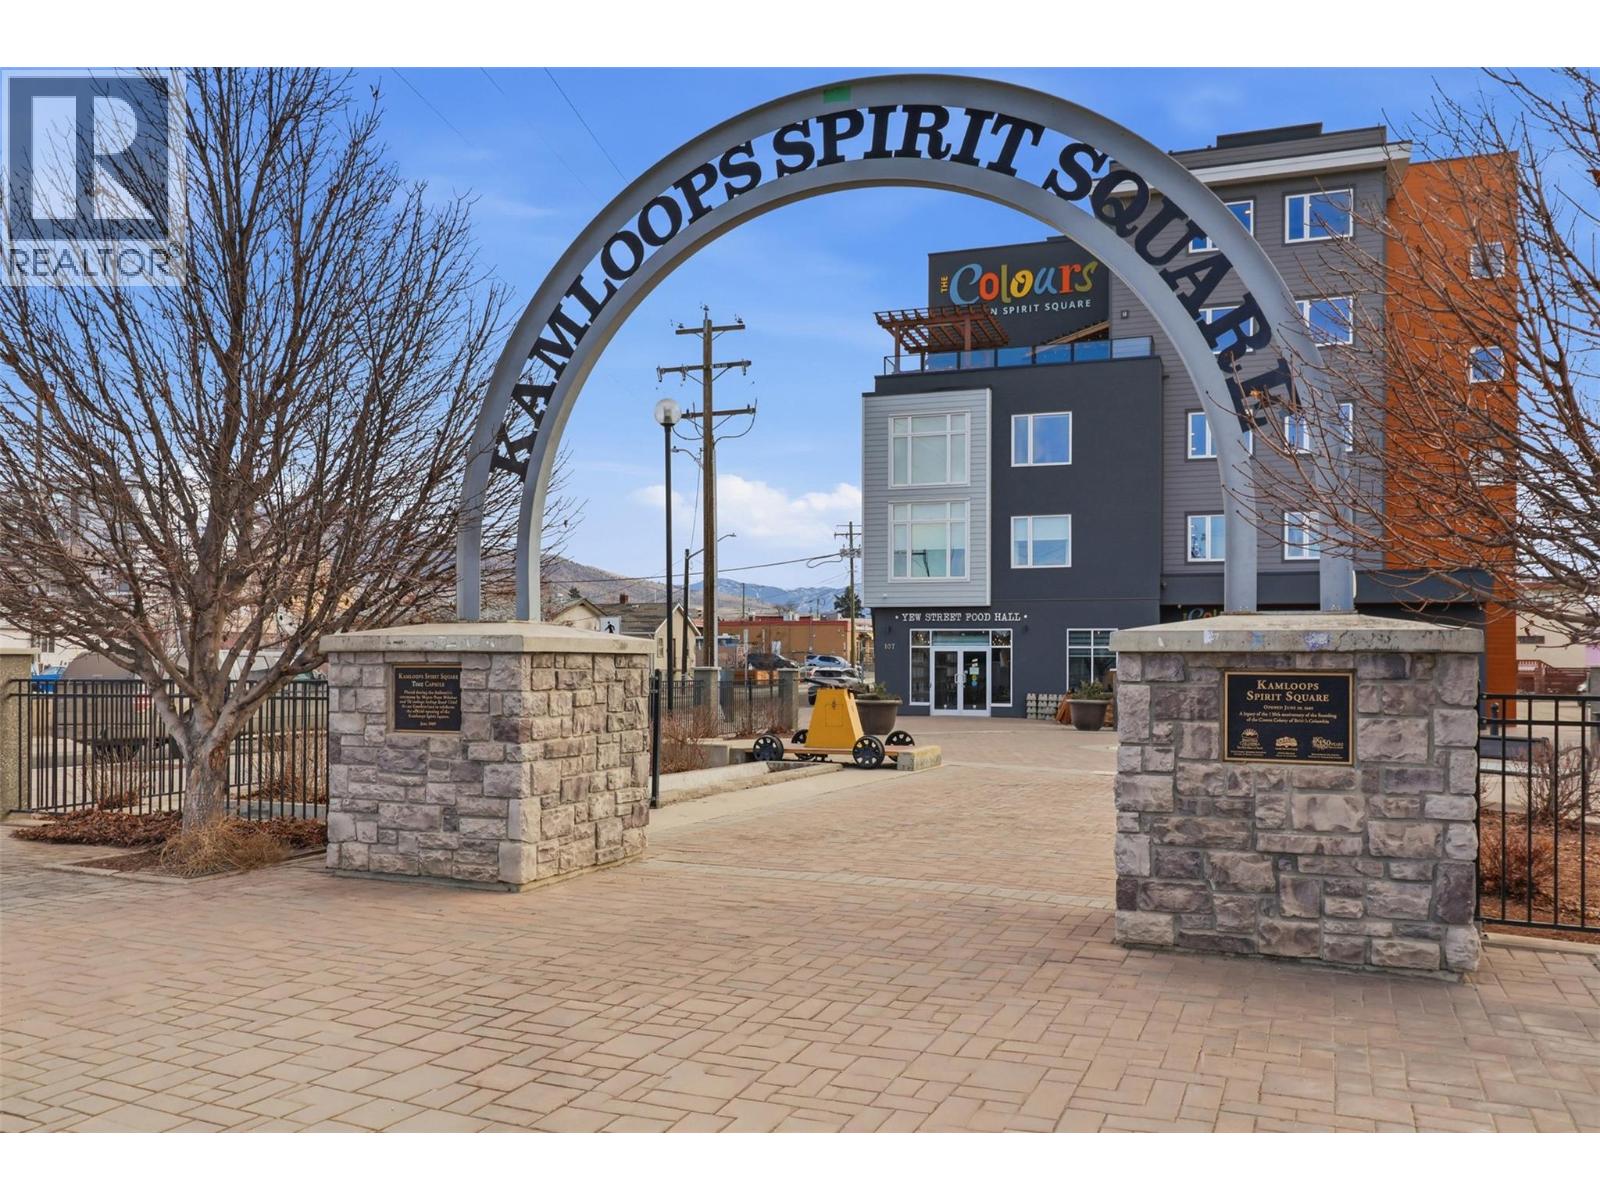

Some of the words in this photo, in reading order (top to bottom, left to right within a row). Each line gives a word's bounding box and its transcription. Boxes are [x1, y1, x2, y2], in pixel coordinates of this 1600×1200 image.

[940, 275, 949, 293] THE
[949, 261, 1098, 305] Colours
[489, 140, 761, 482] KAMLOOPS
[773, 104, 1046, 179] SPIRIT
[1041, 142, 1300, 433] SQUARE
[1002, 304, 1040, 315] SPIRIT
[1045, 299, 1092, 311] SQUARE
[901, 613, 922, 622] YEW
[924, 612, 962, 622] STREET
[965, 612, 991, 622] FOOD
[994, 612, 1021, 622] HALL
